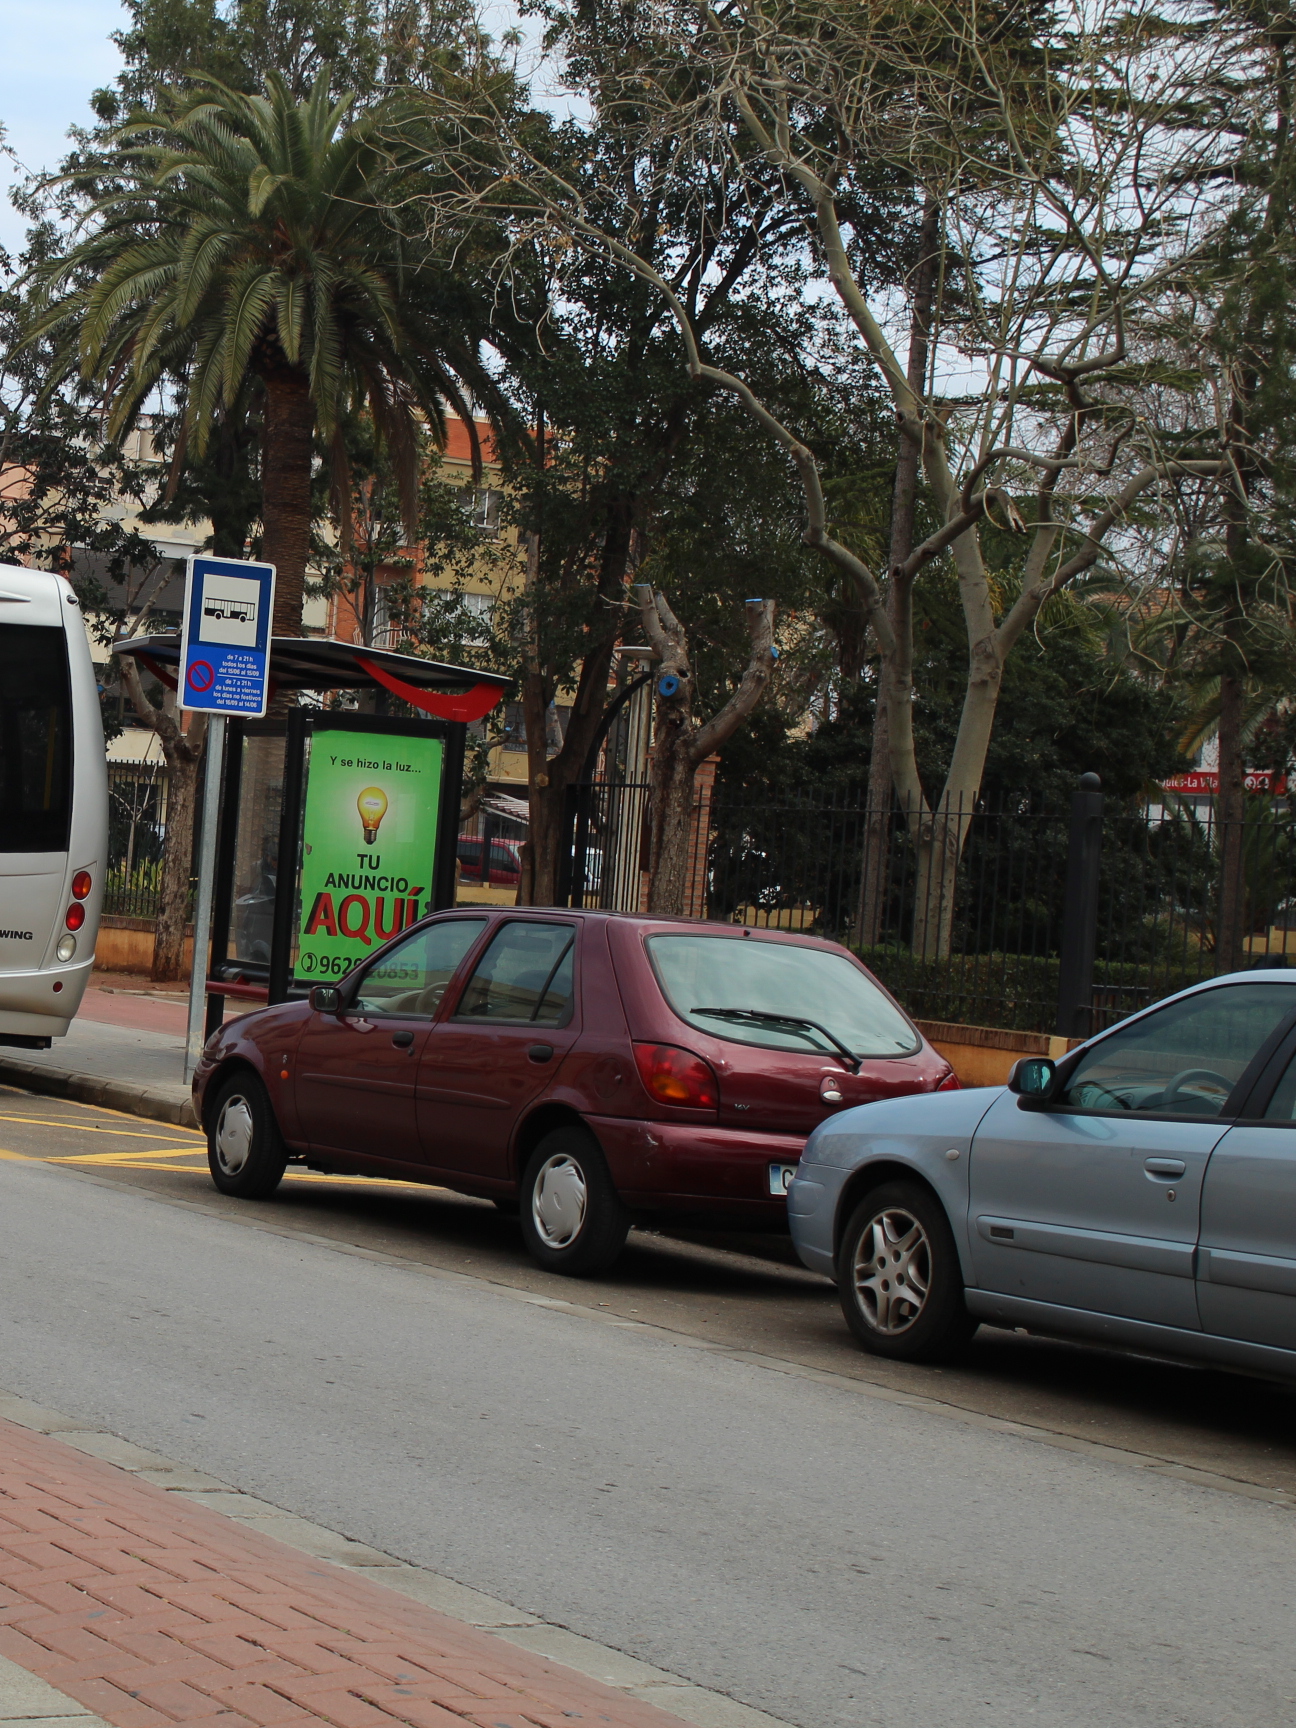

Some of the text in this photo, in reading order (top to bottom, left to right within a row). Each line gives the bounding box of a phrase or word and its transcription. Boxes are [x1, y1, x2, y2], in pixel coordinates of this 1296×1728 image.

[330, 756, 337, 766] Y
[340, 759, 353, 768] se
[356, 758, 379, 769] hizo
[382, 760, 392, 771] la
[357, 854, 380, 870] TU
[324, 873, 409, 893] ANUNCIO
[304, 887, 425, 945] AQUÍ
[0, 930, 33, 940] WING
[319, 955, 419, 980] 9620853
